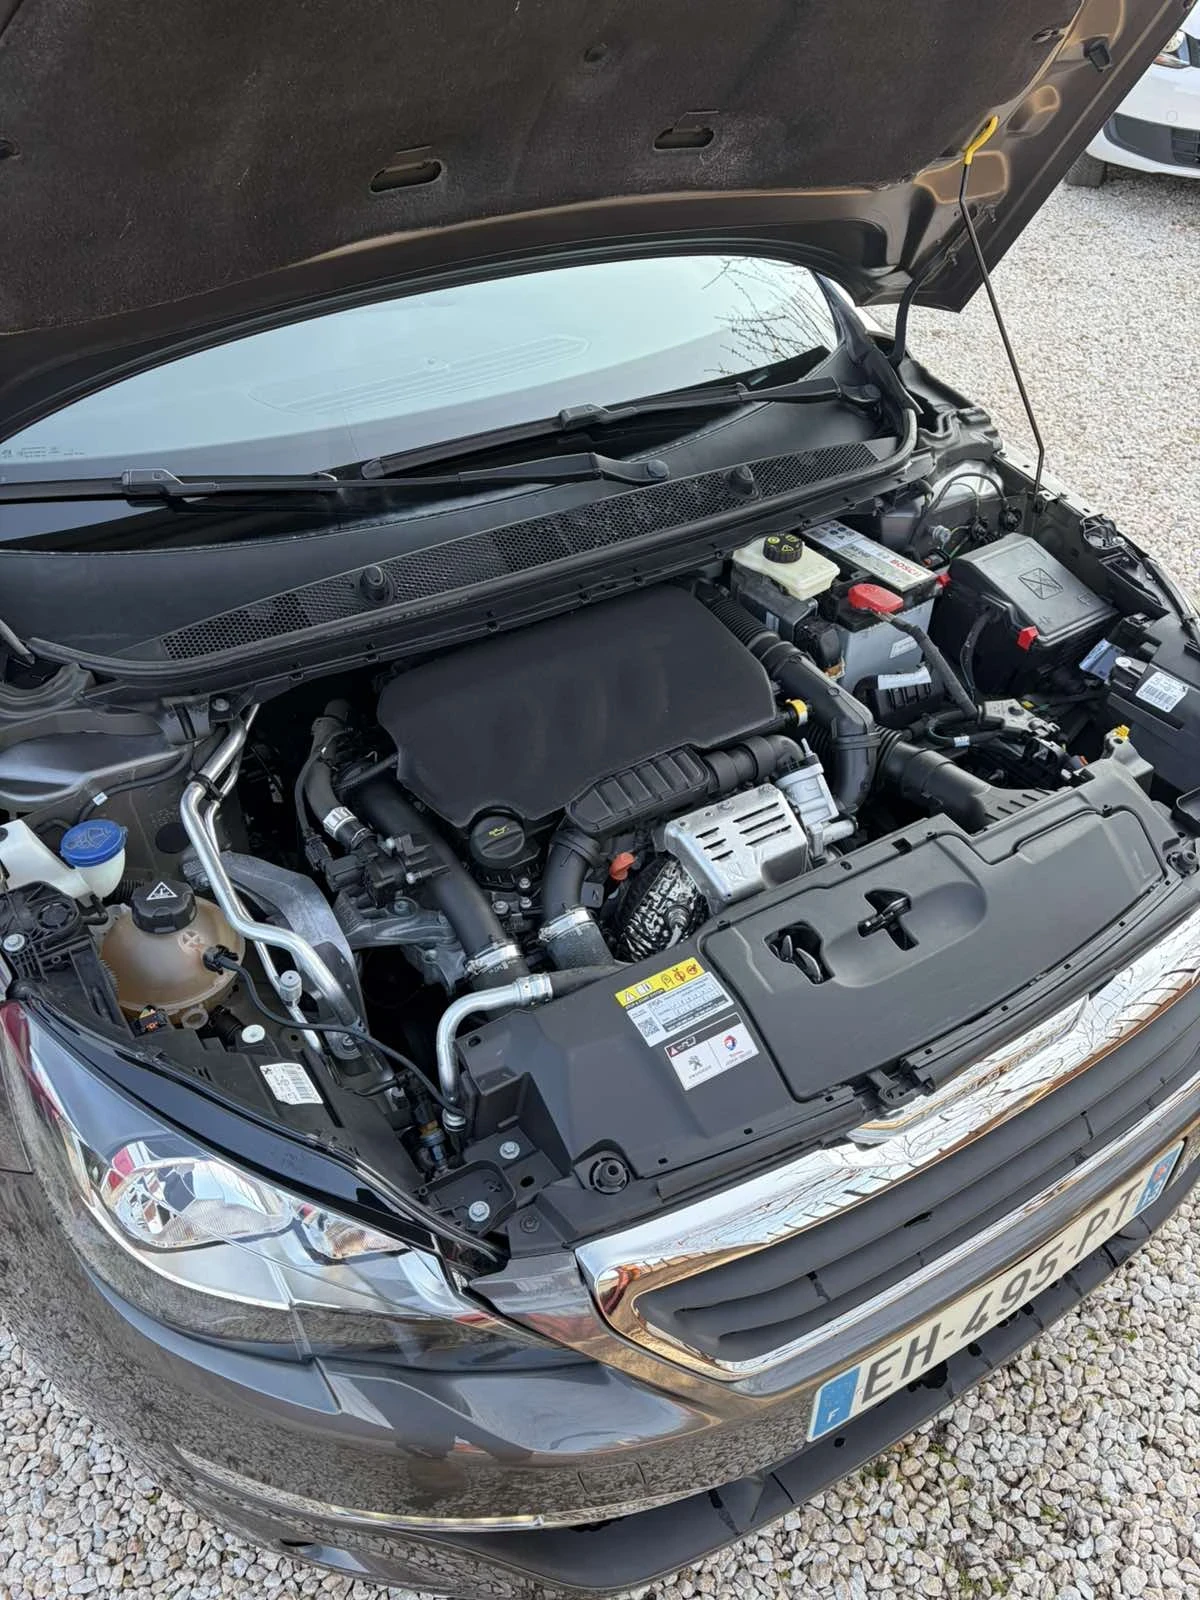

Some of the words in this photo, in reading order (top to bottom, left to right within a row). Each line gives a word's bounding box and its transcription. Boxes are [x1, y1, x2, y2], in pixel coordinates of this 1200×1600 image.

[889, 559, 923, 577] BOSCH
[860, 1178, 1145, 1403] EH-495-PT
[826, 1408, 838, 1424] F
